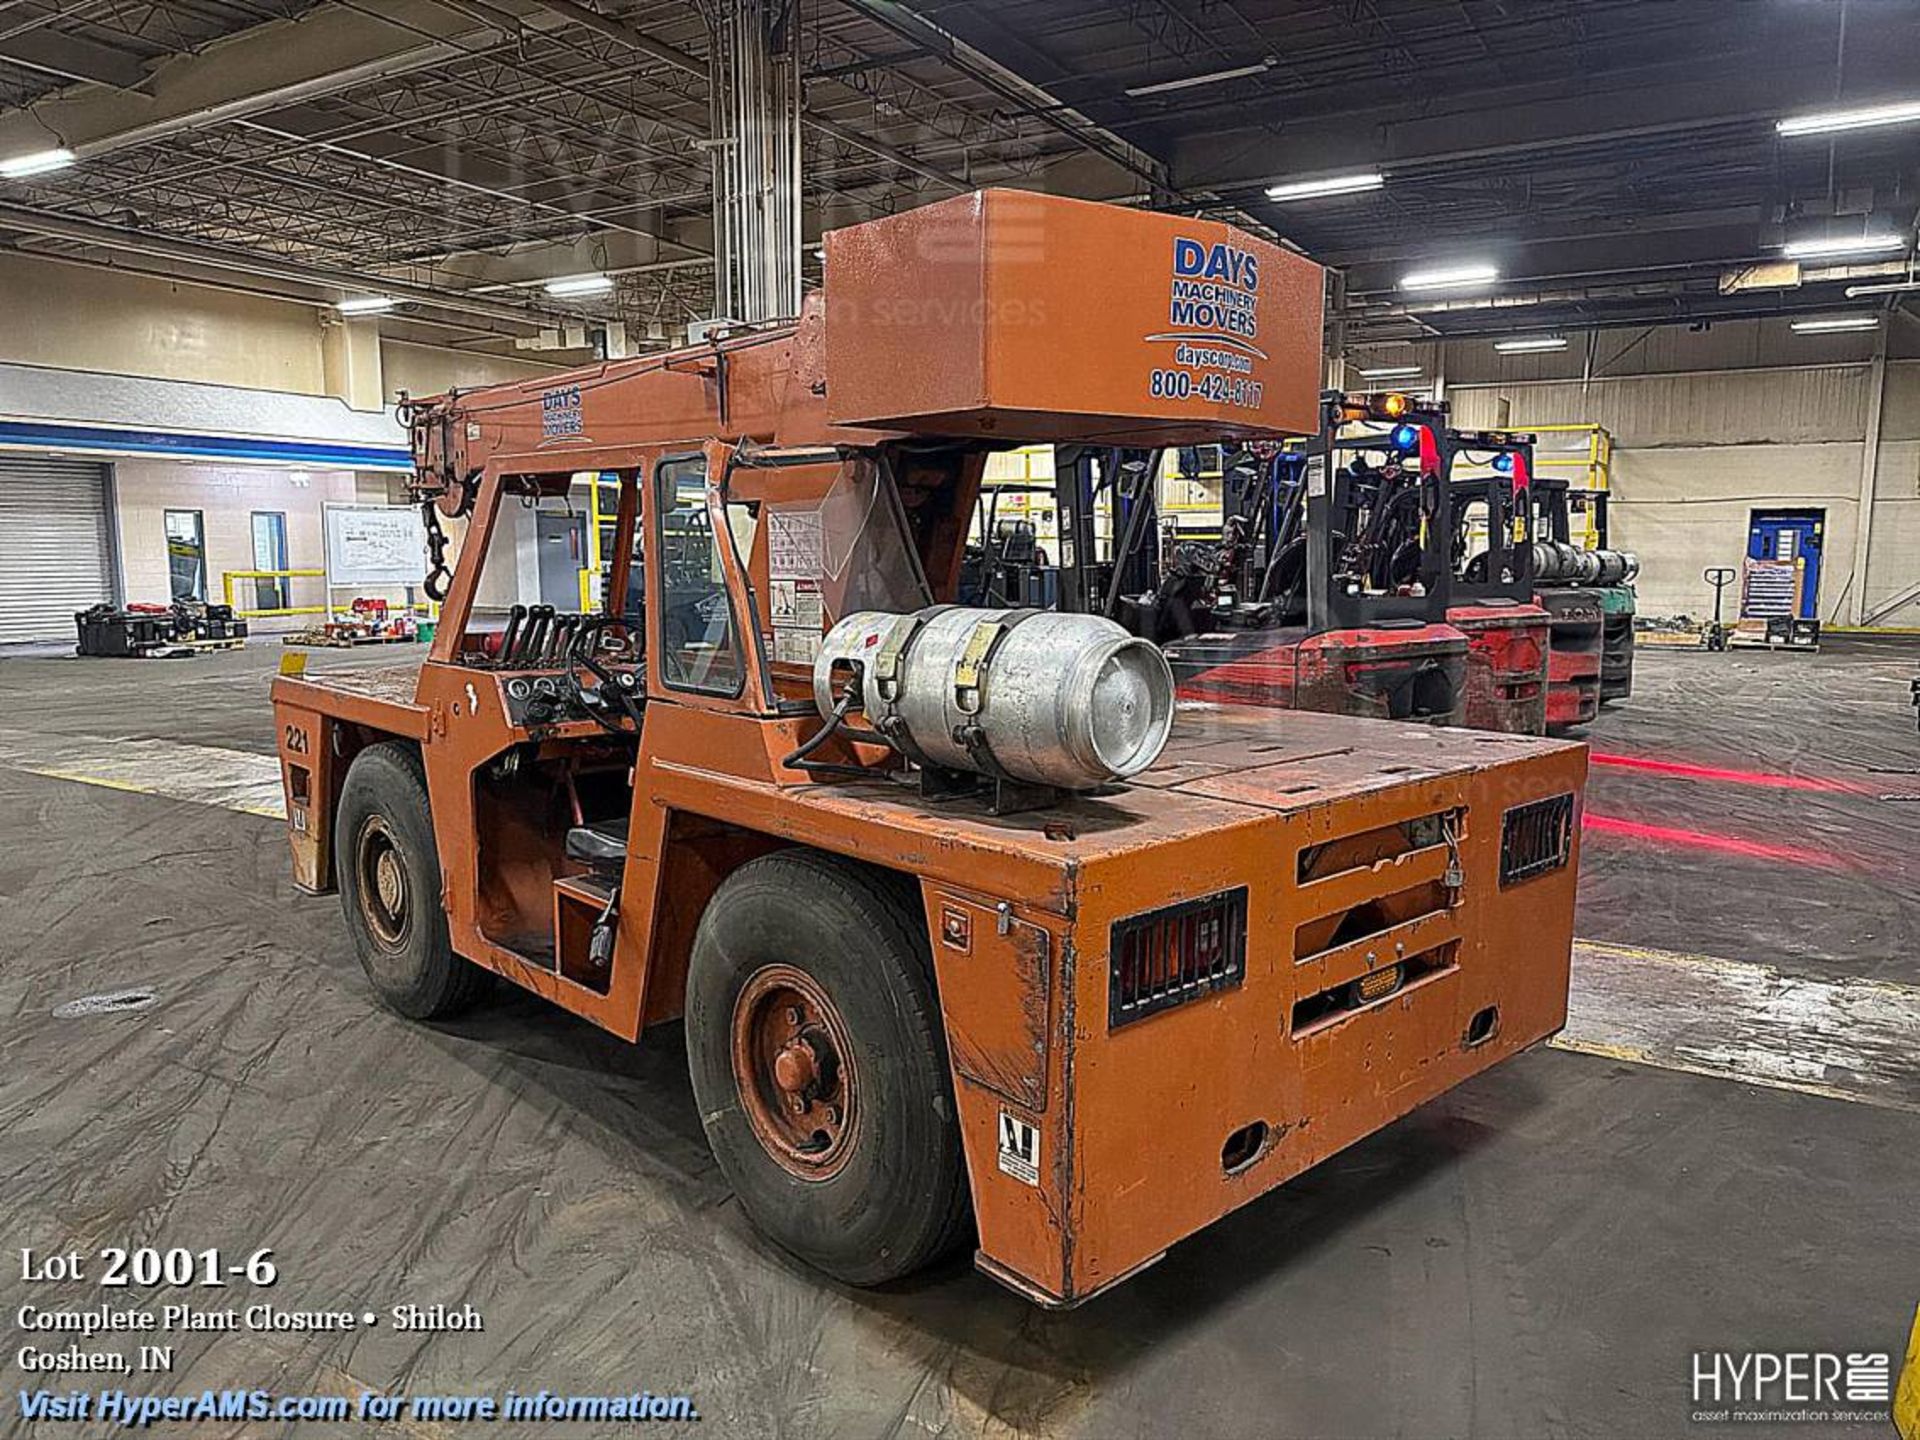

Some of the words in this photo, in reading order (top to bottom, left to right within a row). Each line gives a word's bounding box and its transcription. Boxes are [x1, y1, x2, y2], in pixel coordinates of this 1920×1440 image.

[1174, 237, 1258, 290] DAYS
[1173, 280, 1257, 311] MACHINERY
[1171, 300, 1256, 338] MOVERS
[1176, 344, 1252, 372] dayscorp.com
[543, 385, 581, 410] DAYS
[285, 724, 309, 756] 221
